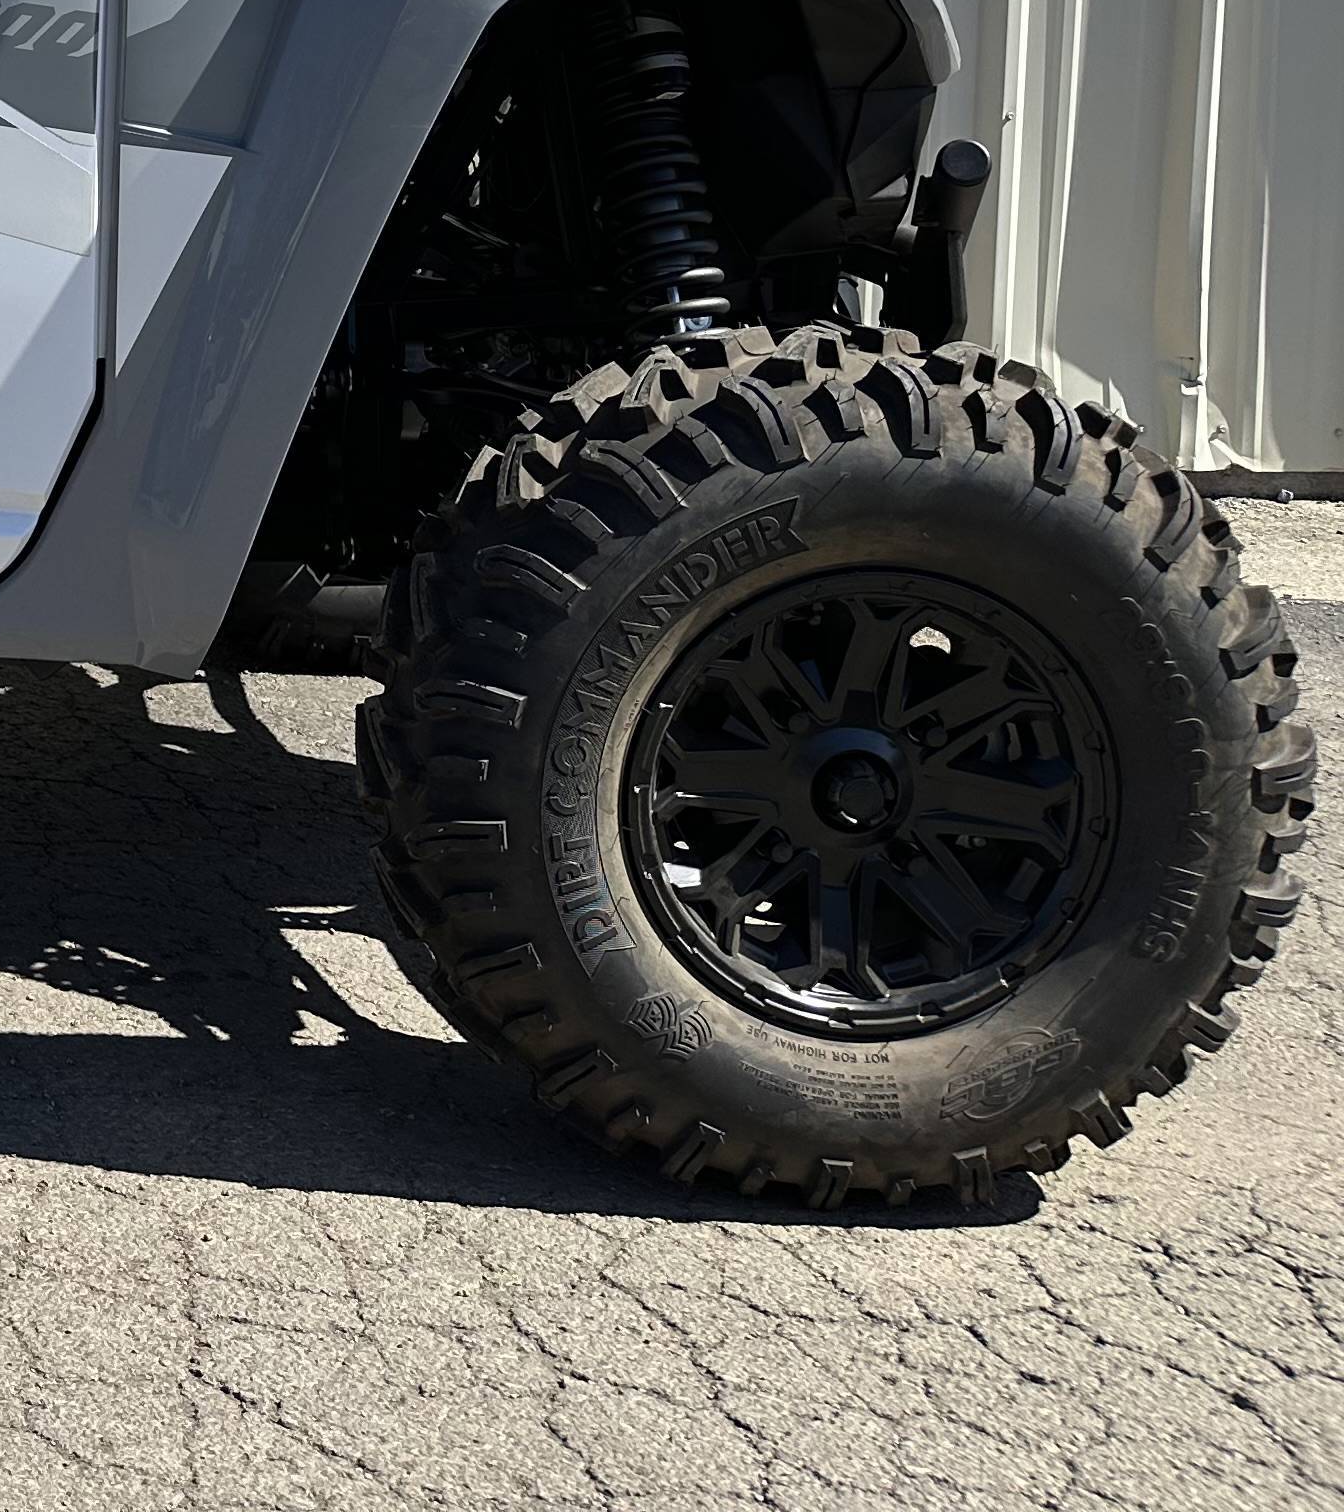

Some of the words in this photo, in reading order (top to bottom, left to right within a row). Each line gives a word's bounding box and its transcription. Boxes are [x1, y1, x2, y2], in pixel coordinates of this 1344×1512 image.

[547, 515, 788, 816] COMMANDER
[550, 833, 618, 955] DIRT
[746, 1024, 769, 1042] USE
[773, 1036, 827, 1059] HIGHWAY
[832, 1051, 858, 1063] FOR
[863, 1052, 890, 1064] NOT
